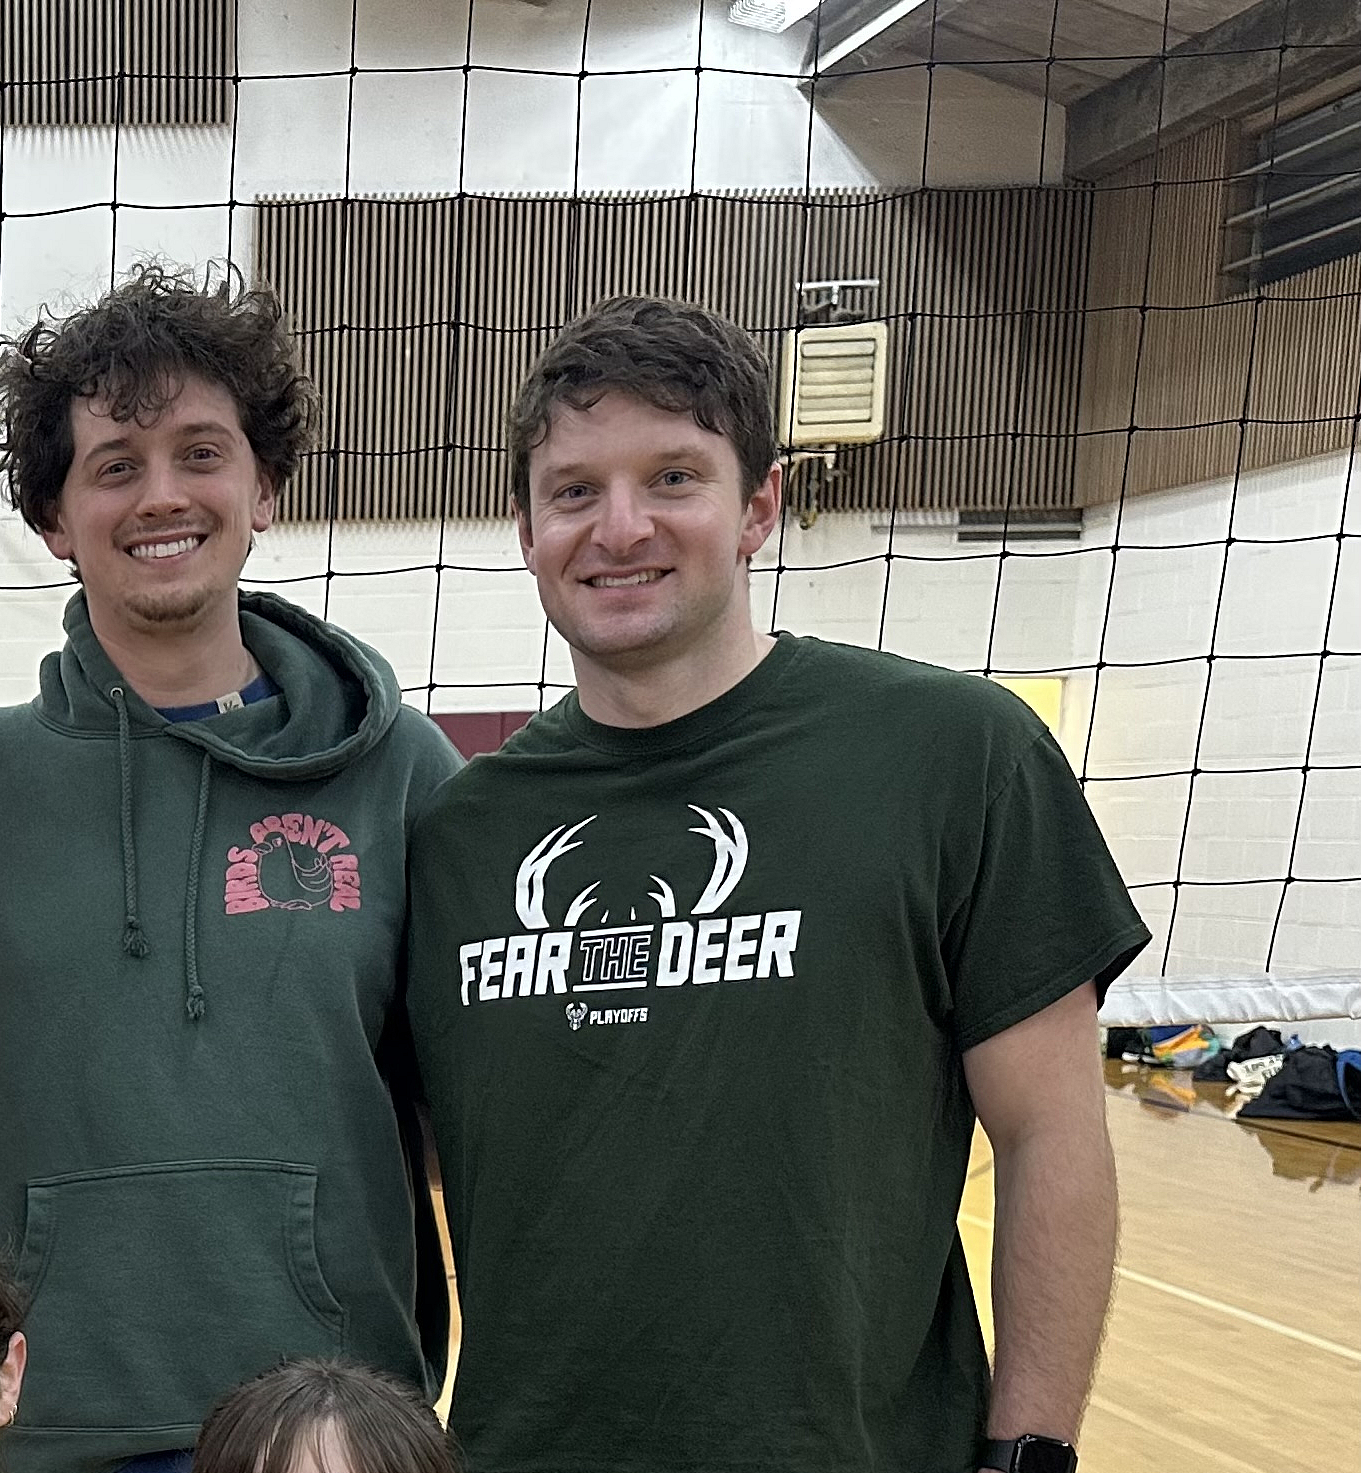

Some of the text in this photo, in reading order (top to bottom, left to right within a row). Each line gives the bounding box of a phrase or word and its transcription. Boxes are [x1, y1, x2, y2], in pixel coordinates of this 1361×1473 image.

[249, 813, 350, 853] AREN'T
[329, 854, 361, 912] REAL
[460, 910, 802, 1005] FEAR THE DEER
[589, 1007, 648, 1025] PLAYOFFS
